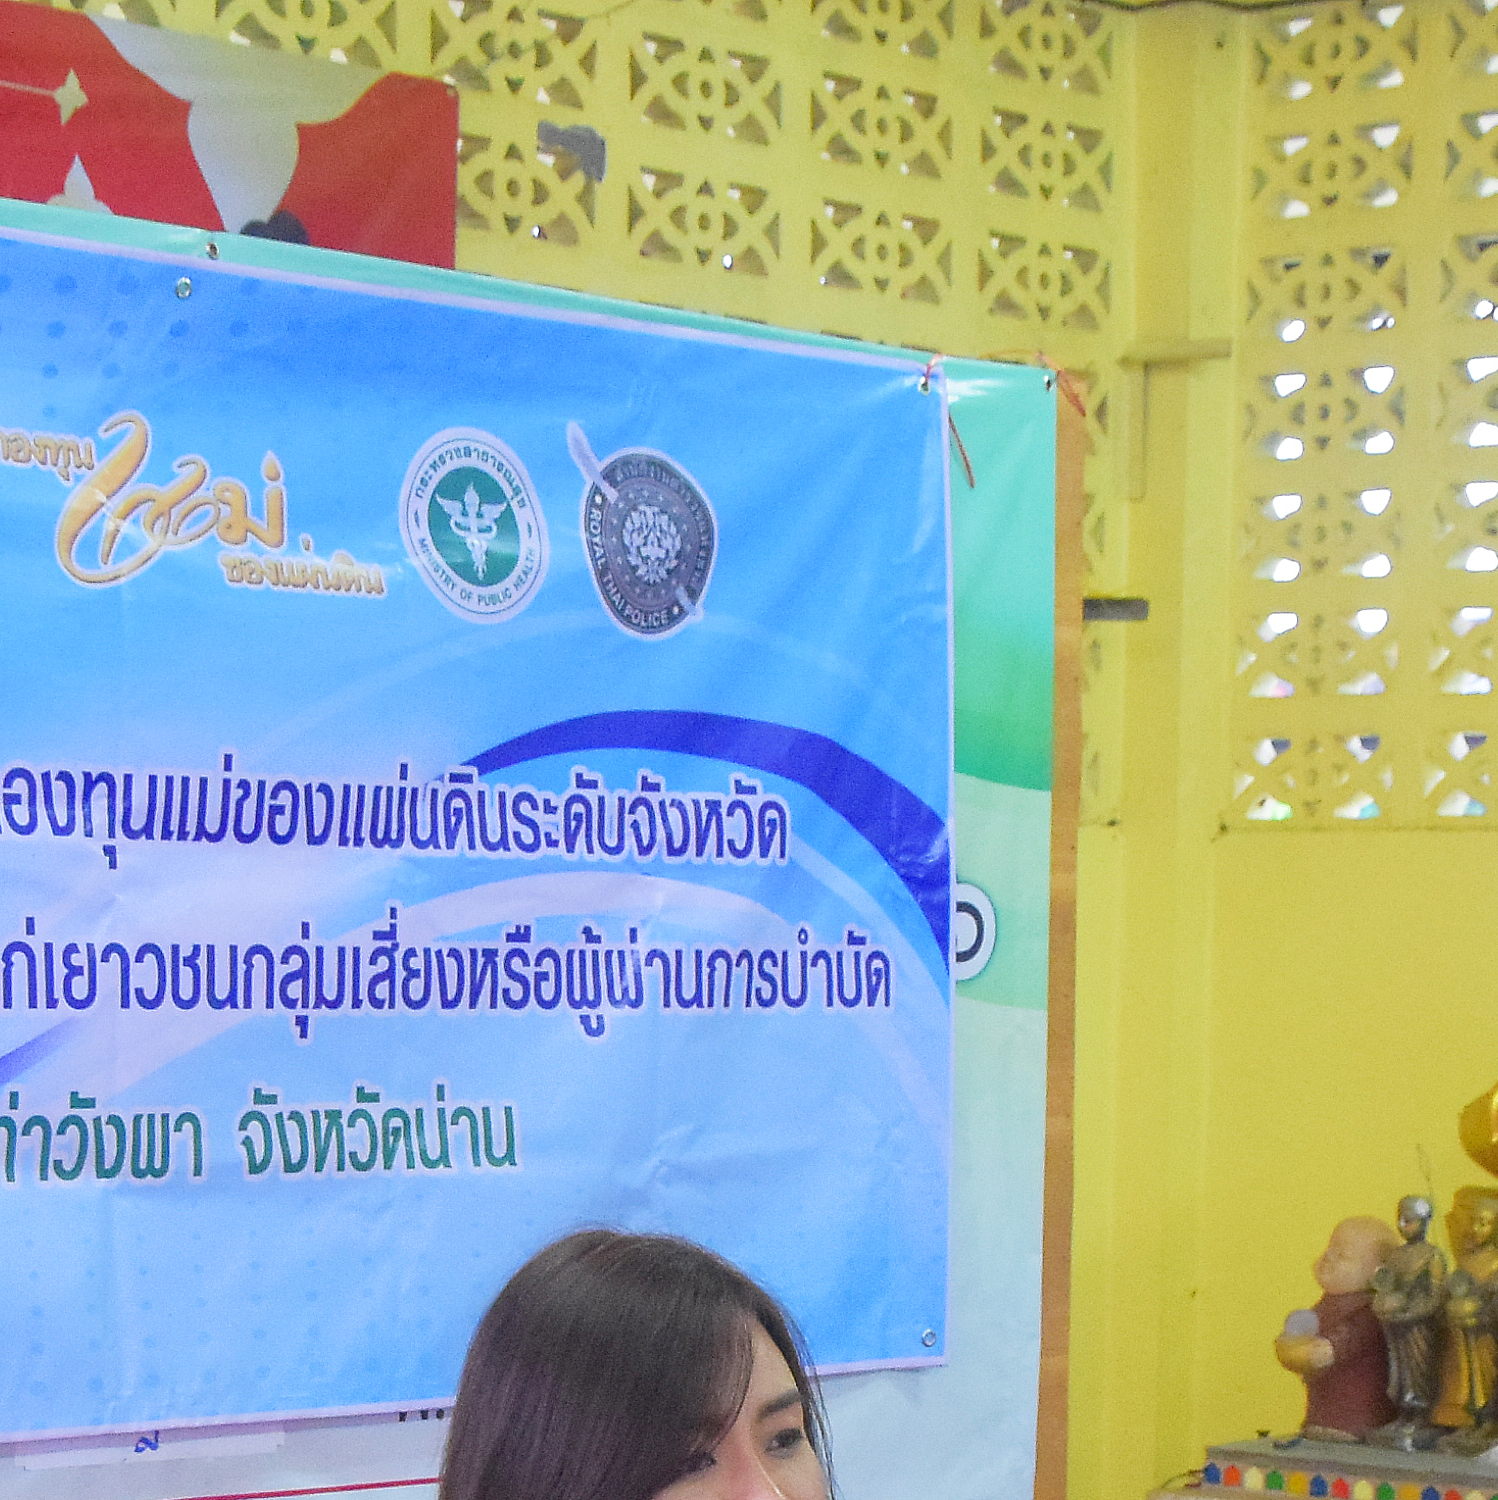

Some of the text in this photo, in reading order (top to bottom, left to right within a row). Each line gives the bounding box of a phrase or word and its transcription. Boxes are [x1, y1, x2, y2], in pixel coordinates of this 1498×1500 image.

[460, 588, 474, 602] OF
[477, 587, 513, 606] PUBLIC
[589, 508, 669, 627] ROYAL THAI POLICE
[237, 1083, 518, 1176] จังหวัดน่าน
